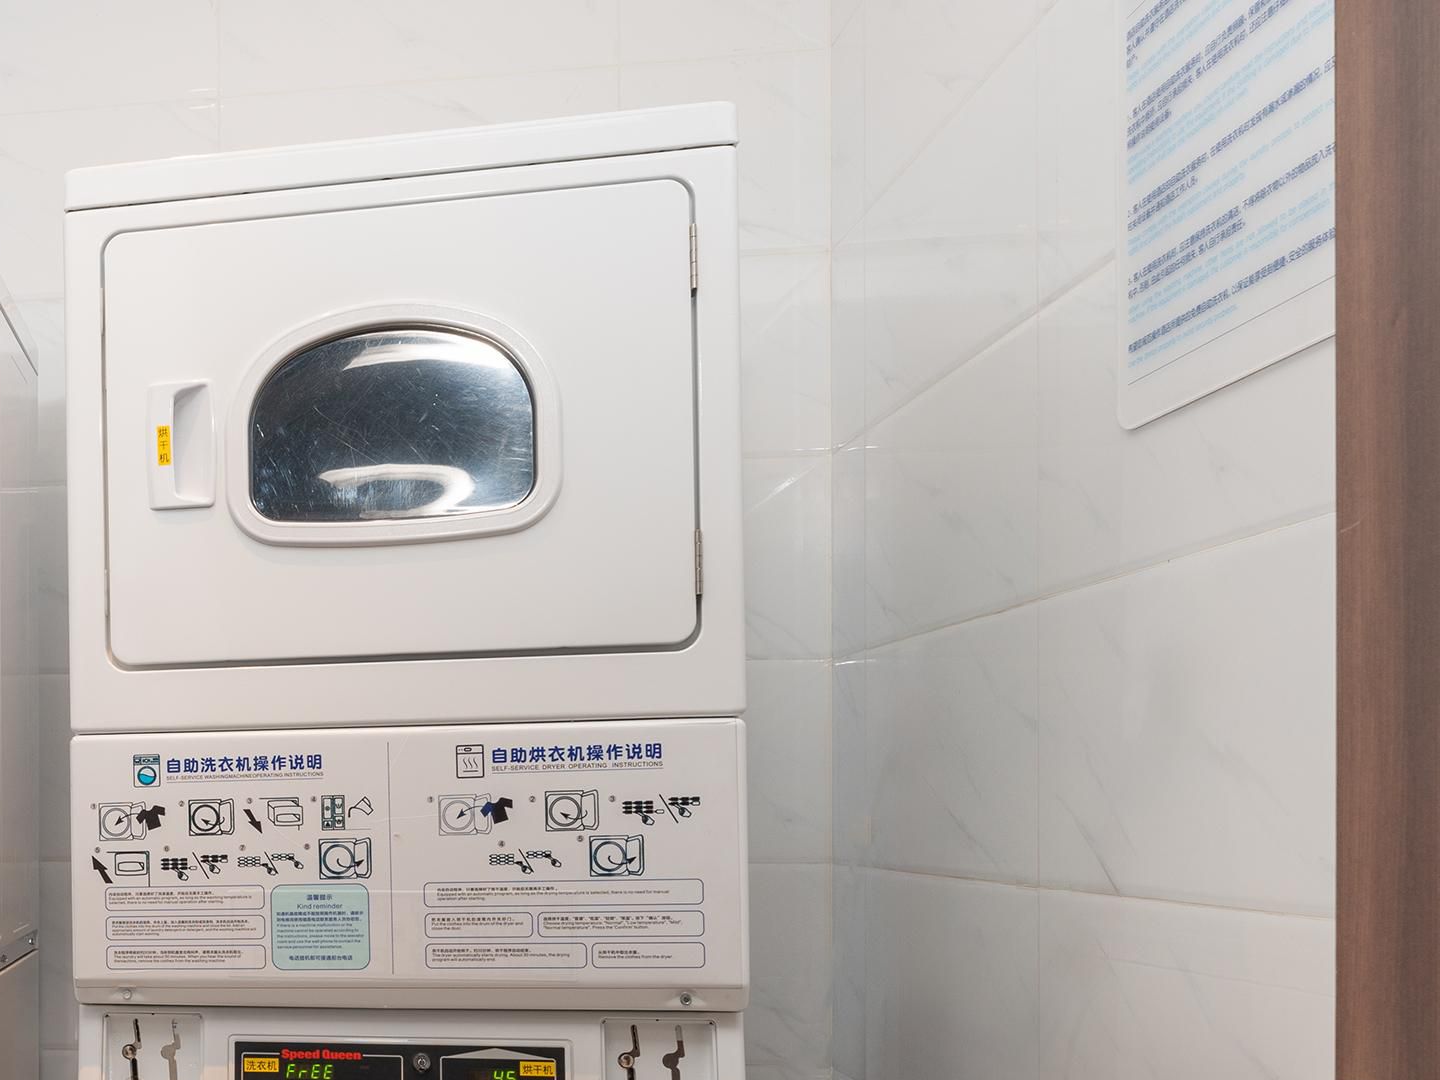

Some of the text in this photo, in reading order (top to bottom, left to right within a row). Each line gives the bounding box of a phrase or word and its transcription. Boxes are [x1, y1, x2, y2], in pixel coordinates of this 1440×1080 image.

[158, 428, 170, 463] 烘干机
[491, 742, 663, 763] 自助烘衣机操作说明
[166, 754, 323, 774] 自助洗衣机操作说明
[280, 1048, 362, 1060] Speed Queen
[246, 1060, 278, 1071] 洗衣机
[522, 1064, 554, 1075] 烘干机
